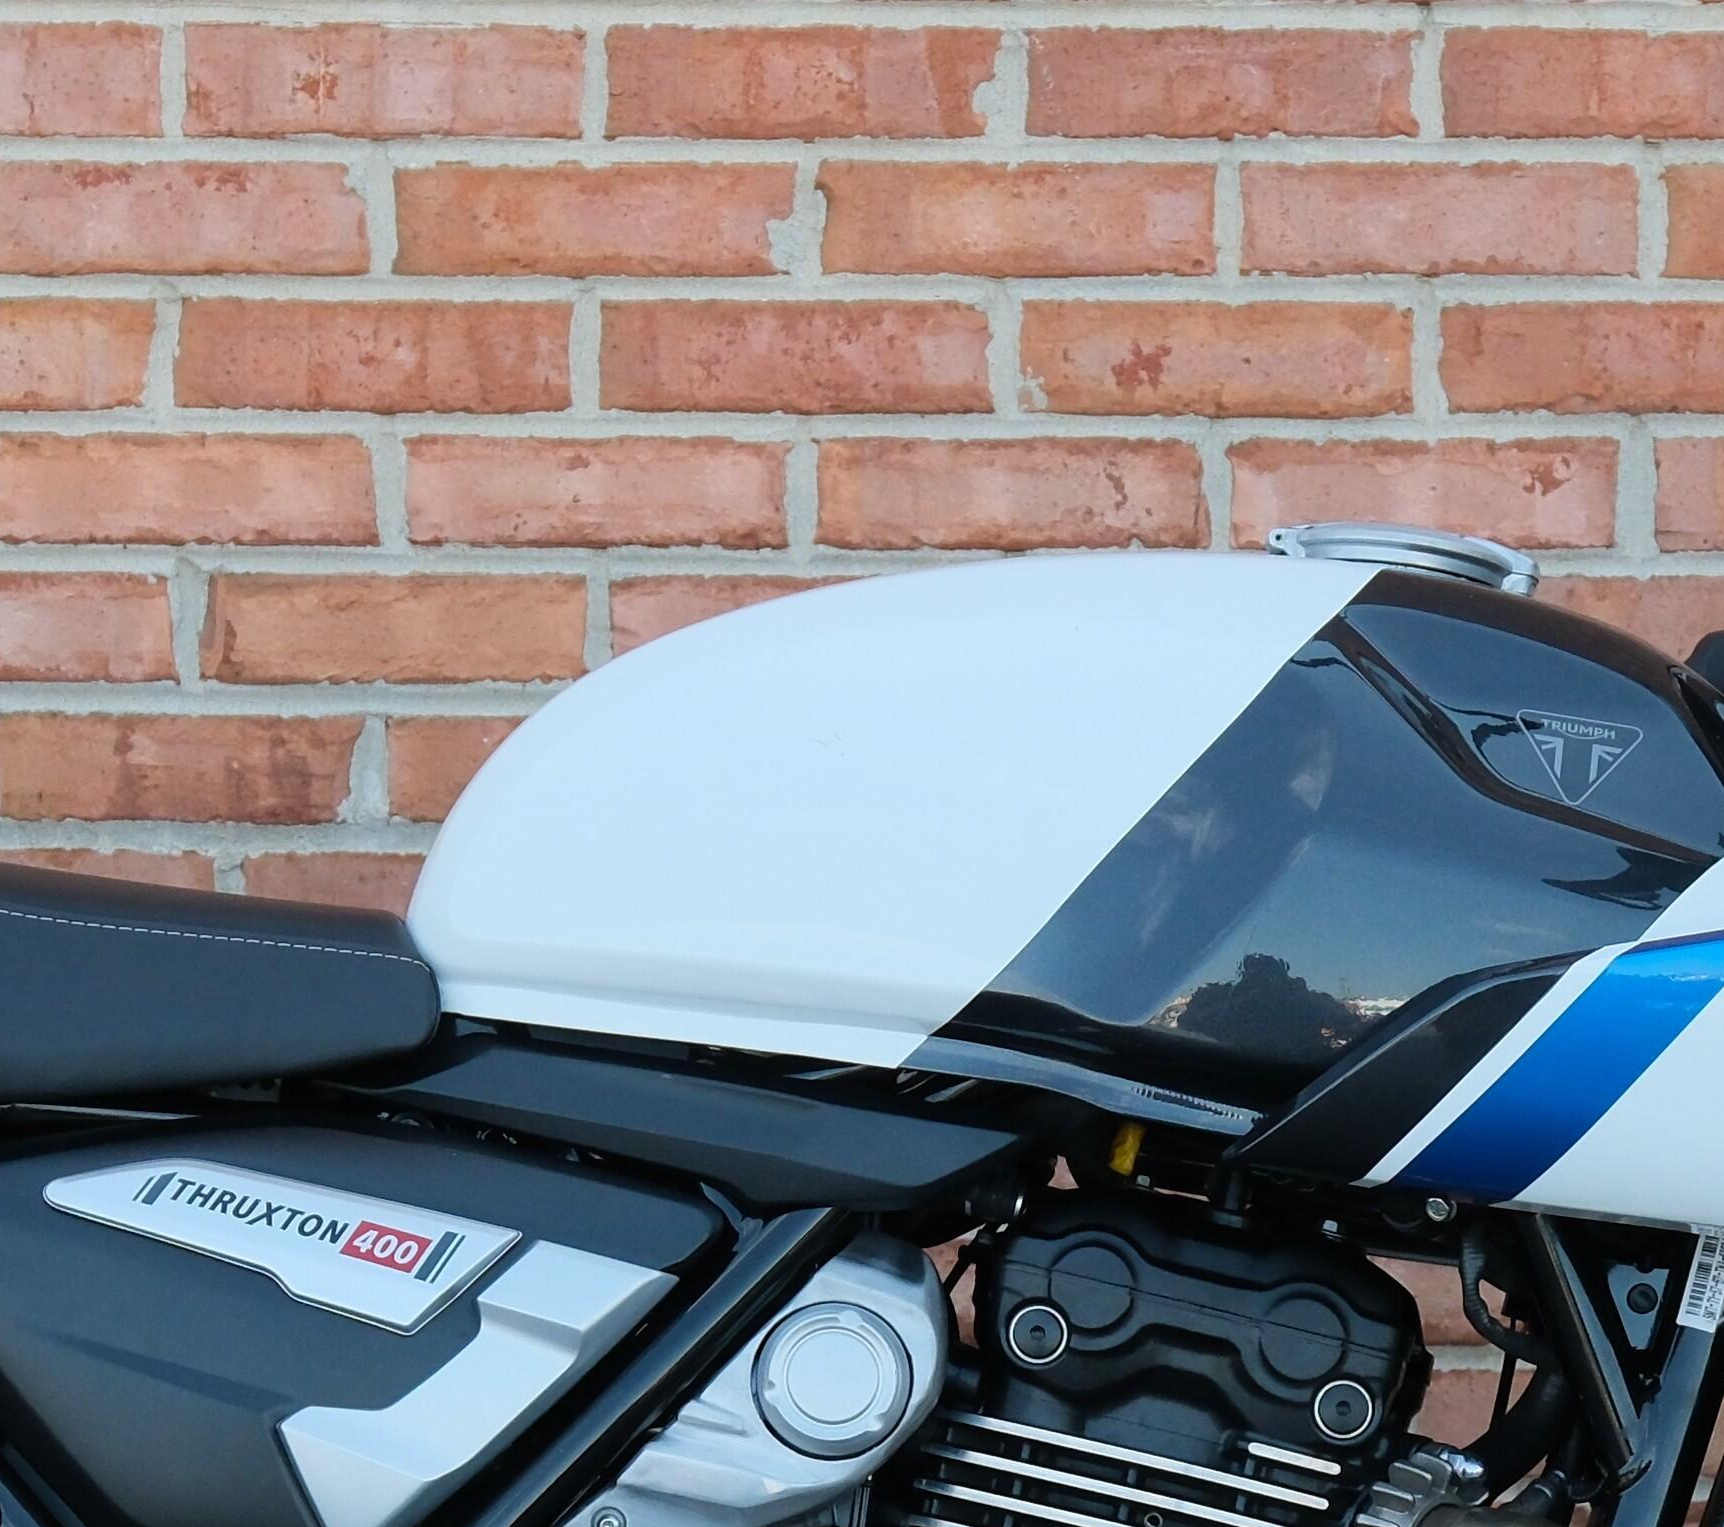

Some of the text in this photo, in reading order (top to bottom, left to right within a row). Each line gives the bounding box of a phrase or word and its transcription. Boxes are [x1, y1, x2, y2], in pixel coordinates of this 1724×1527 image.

[1540, 718, 1616, 740] TRIUMPH
[169, 1177, 420, 1265] THRUXTON 400
